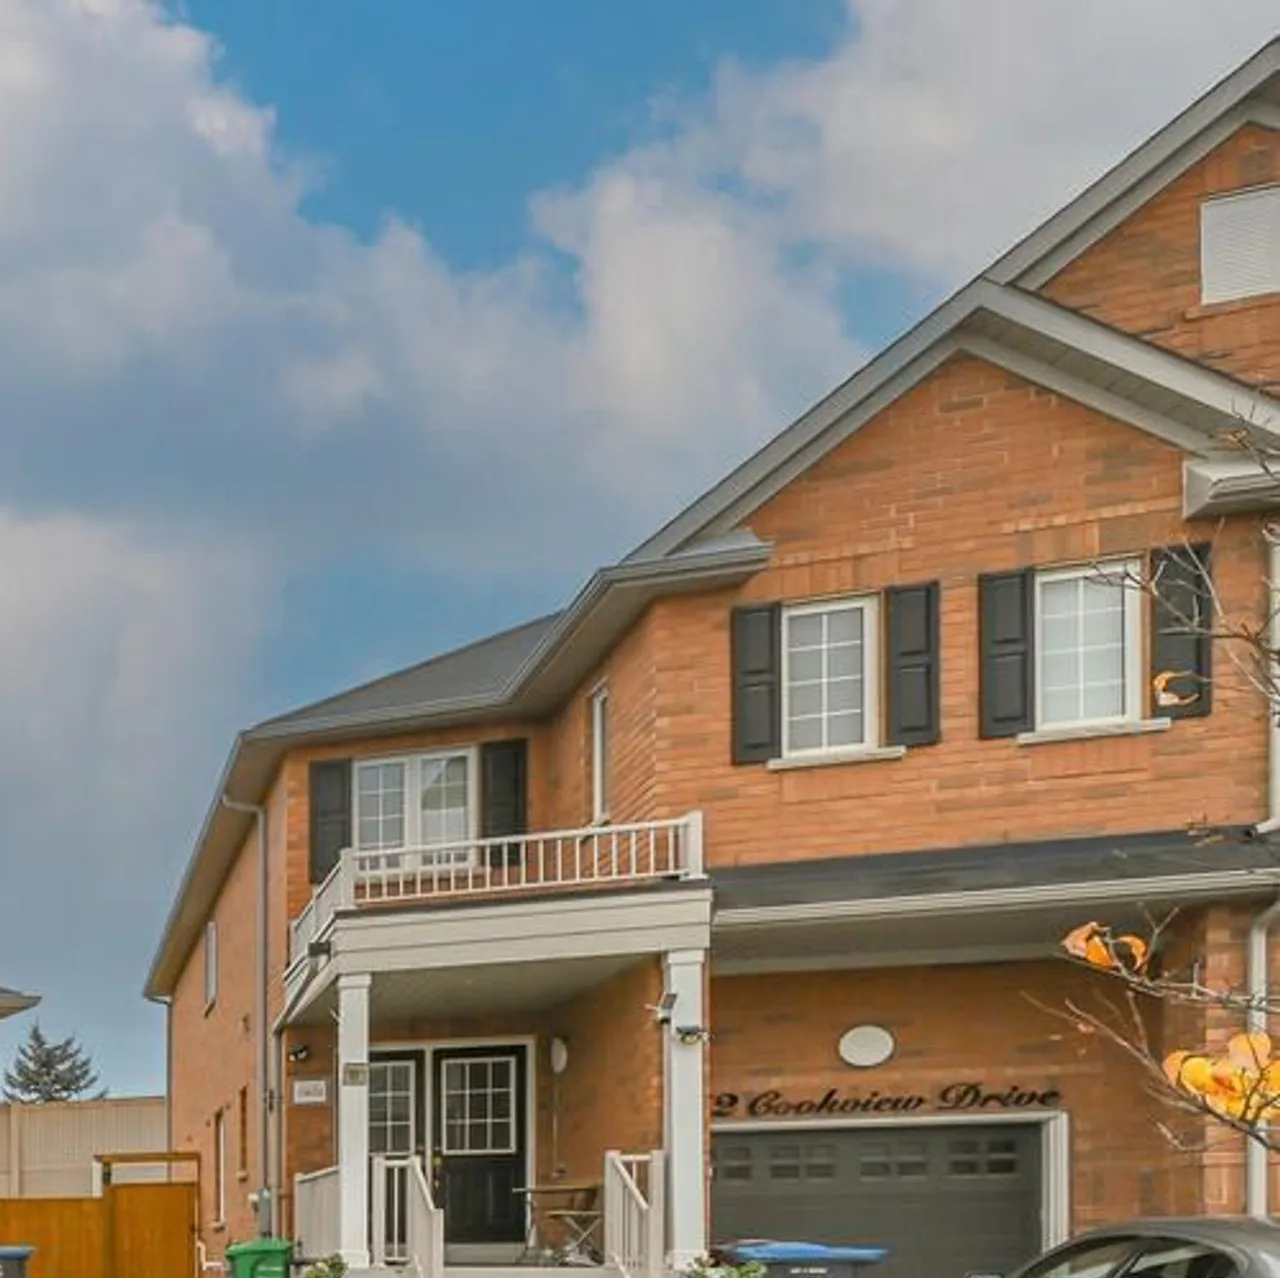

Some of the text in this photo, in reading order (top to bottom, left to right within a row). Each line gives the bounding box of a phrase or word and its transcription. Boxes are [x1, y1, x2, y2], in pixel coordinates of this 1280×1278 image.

[712, 1081, 1060, 1118] 2 Cookview Drive
